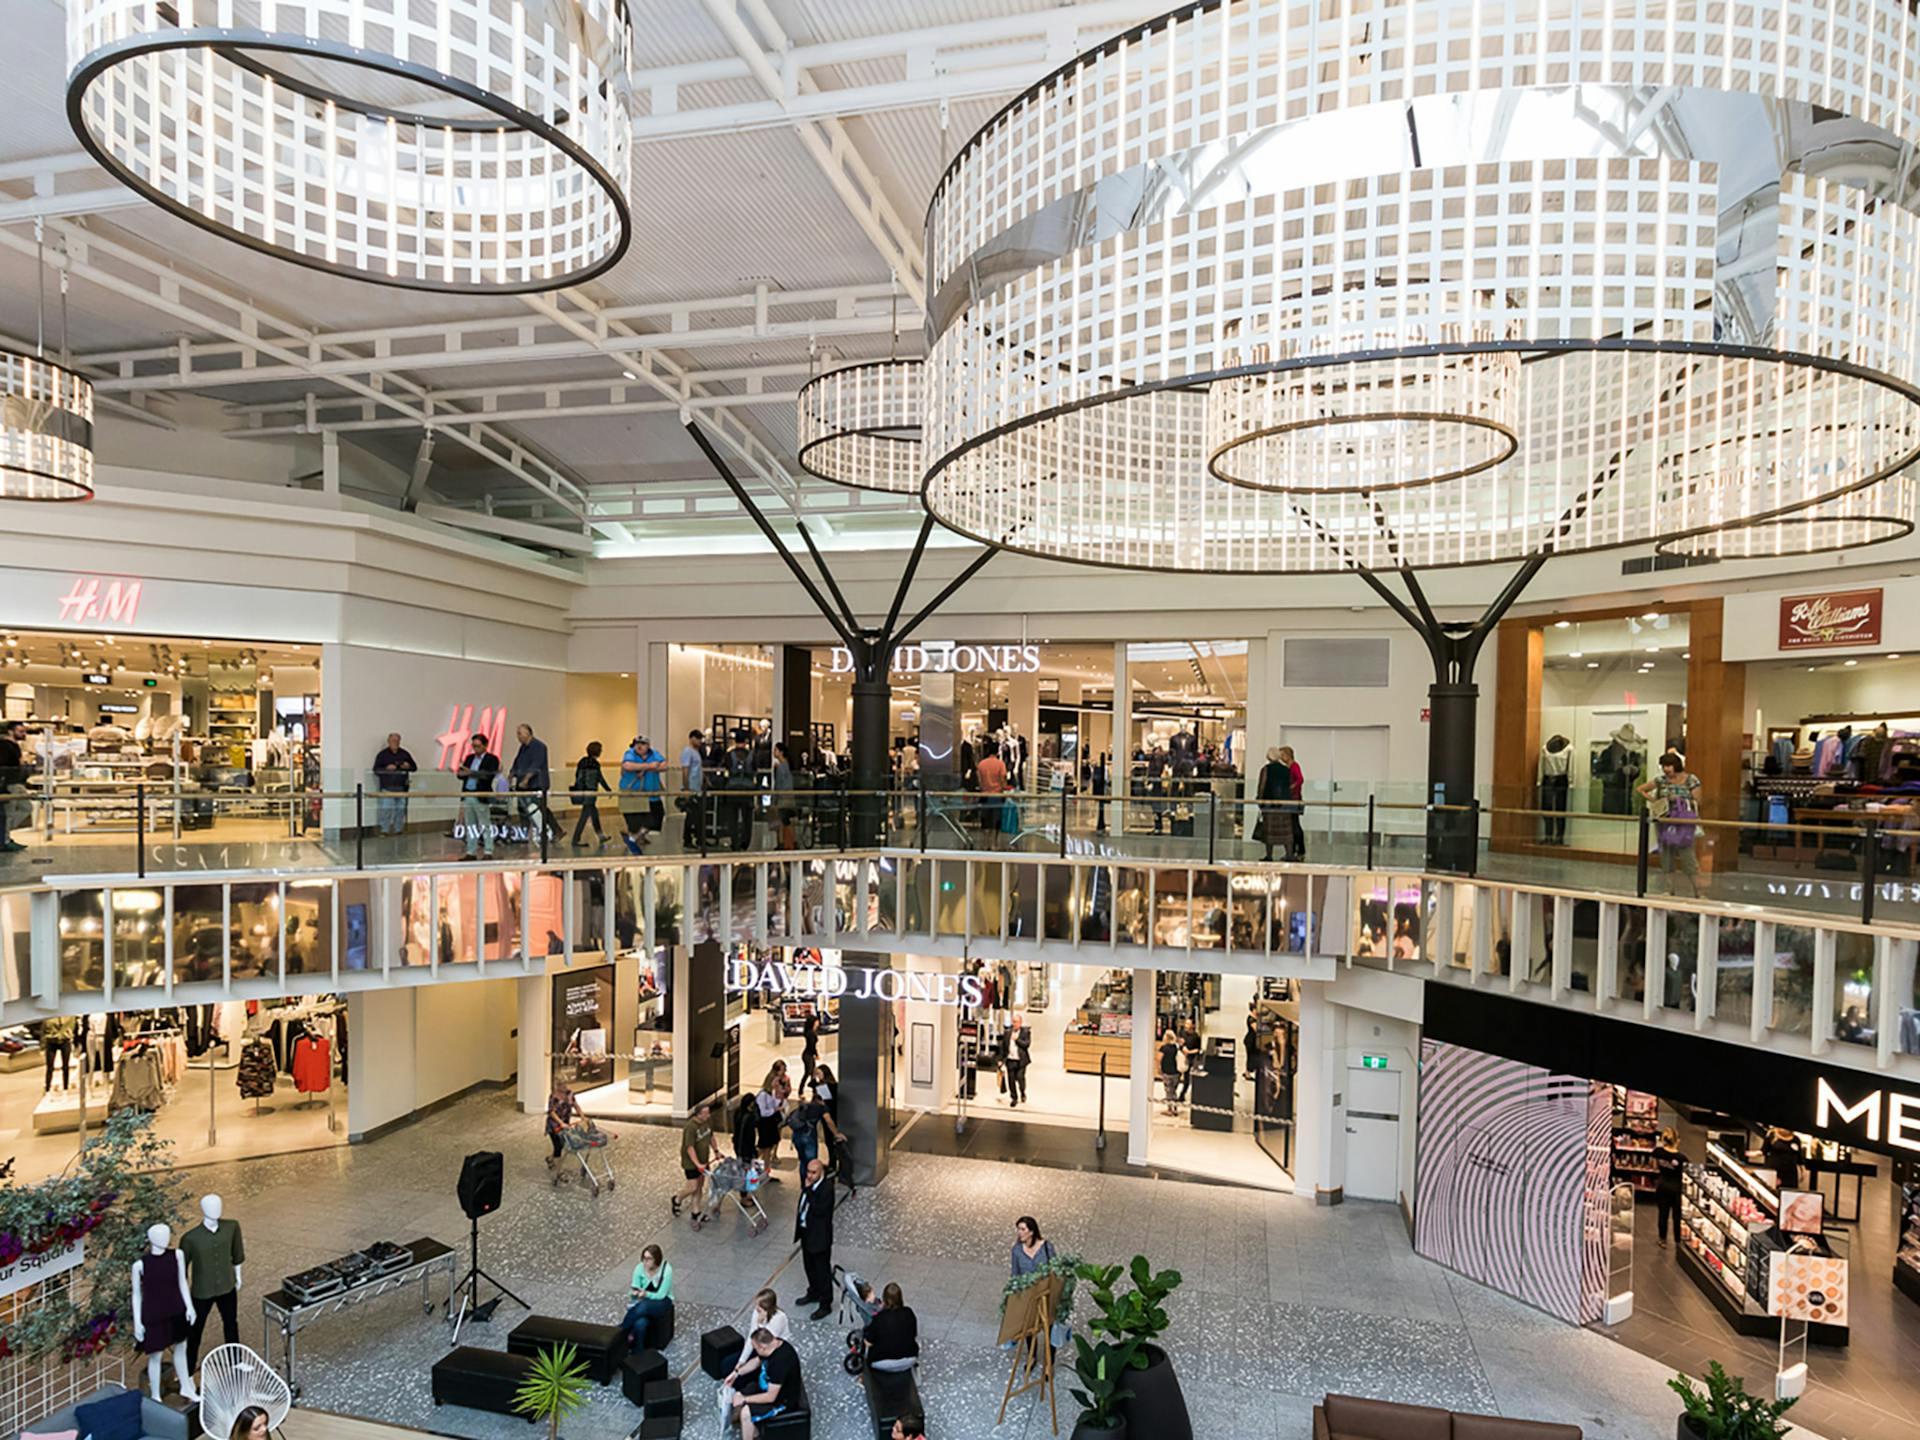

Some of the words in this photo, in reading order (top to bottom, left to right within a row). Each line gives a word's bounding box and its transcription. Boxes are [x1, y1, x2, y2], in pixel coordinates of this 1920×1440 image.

[58, 578, 143, 625] H&M
[830, 646, 928, 672] DID
[935, 645, 1040, 673] JONES
[730, 959, 848, 996] DAVID
[855, 967, 982, 1008] JONES
[1816, 1076, 1920, 1152] ME
